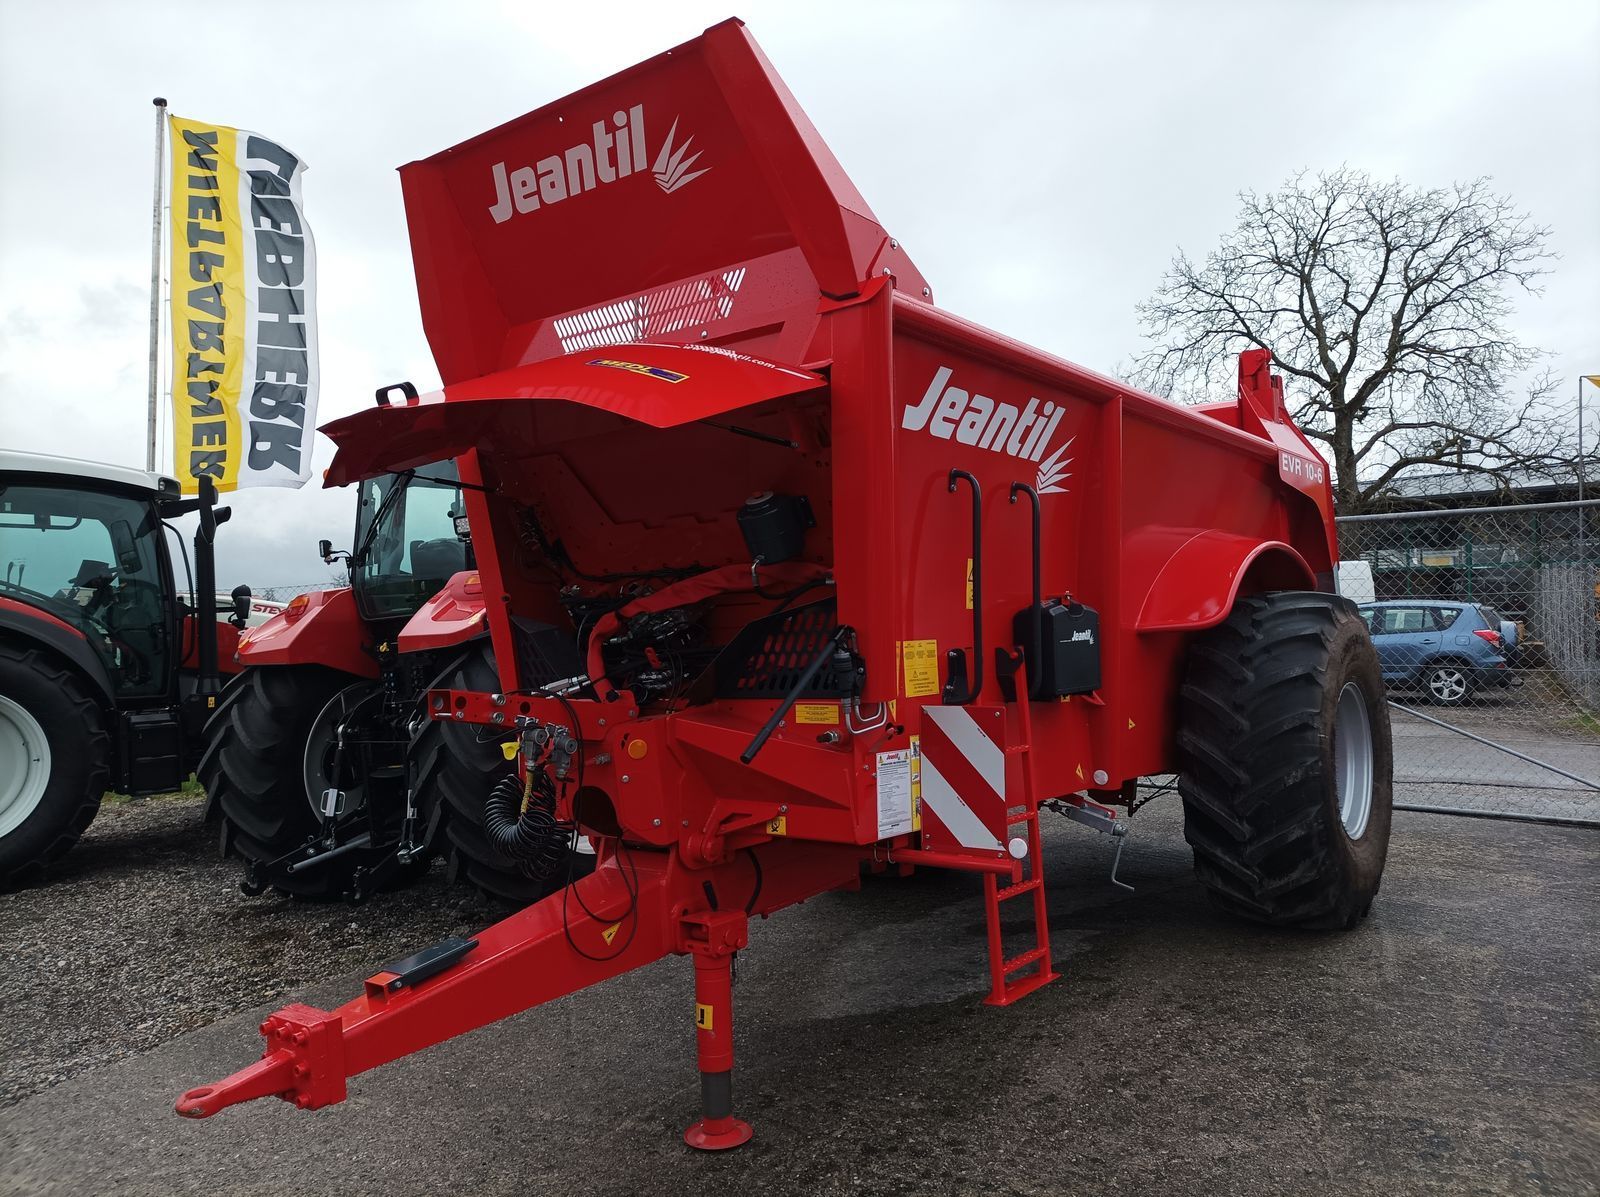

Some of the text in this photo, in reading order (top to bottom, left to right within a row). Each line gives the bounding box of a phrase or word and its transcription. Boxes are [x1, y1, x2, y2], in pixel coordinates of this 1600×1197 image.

[488, 104, 648, 225] Jeantil
[901, 366, 1067, 463] Jeantil
[1282, 453, 1302, 476] EVR
